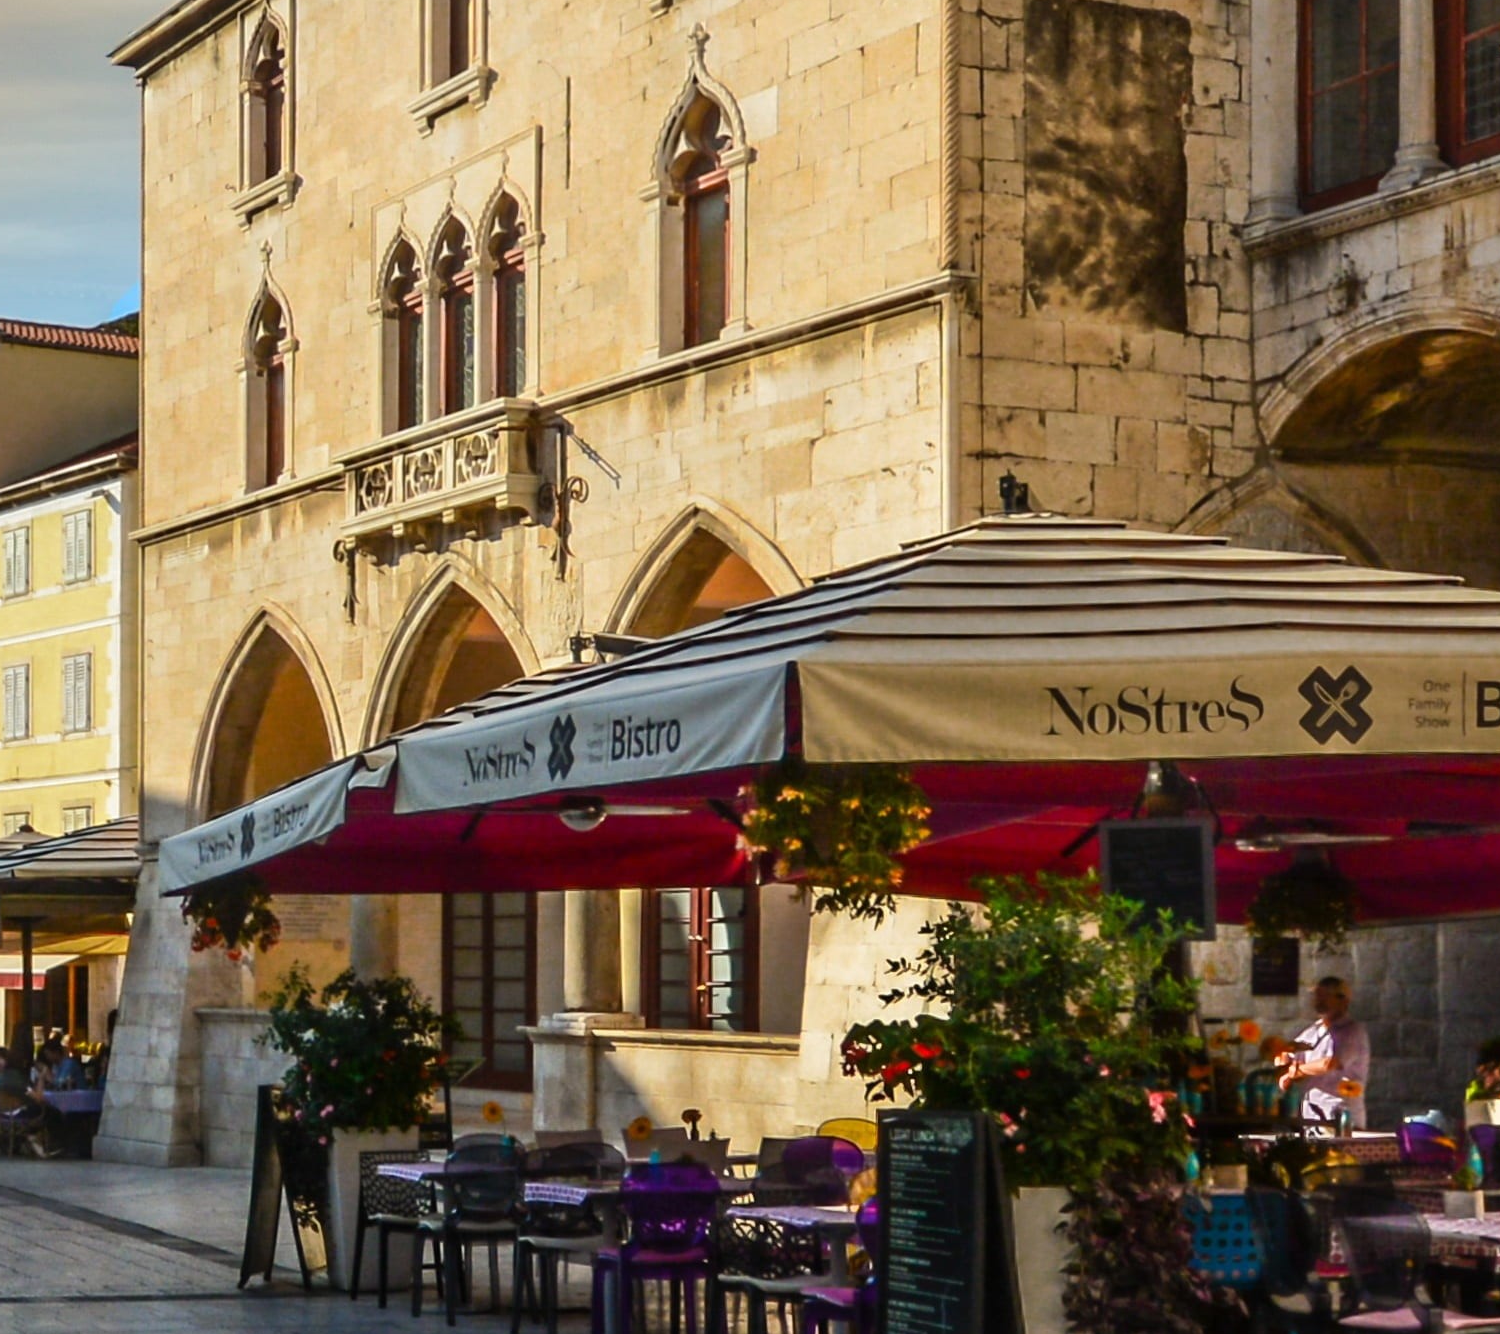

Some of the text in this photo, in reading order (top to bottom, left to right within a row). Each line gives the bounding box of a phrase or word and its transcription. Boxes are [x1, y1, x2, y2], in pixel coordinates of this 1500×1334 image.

[1423, 680, 1450, 692] One
[1408, 698, 1450, 713] Family
[1415, 716, 1449, 728] Show
[611, 715, 682, 762] Bistro
